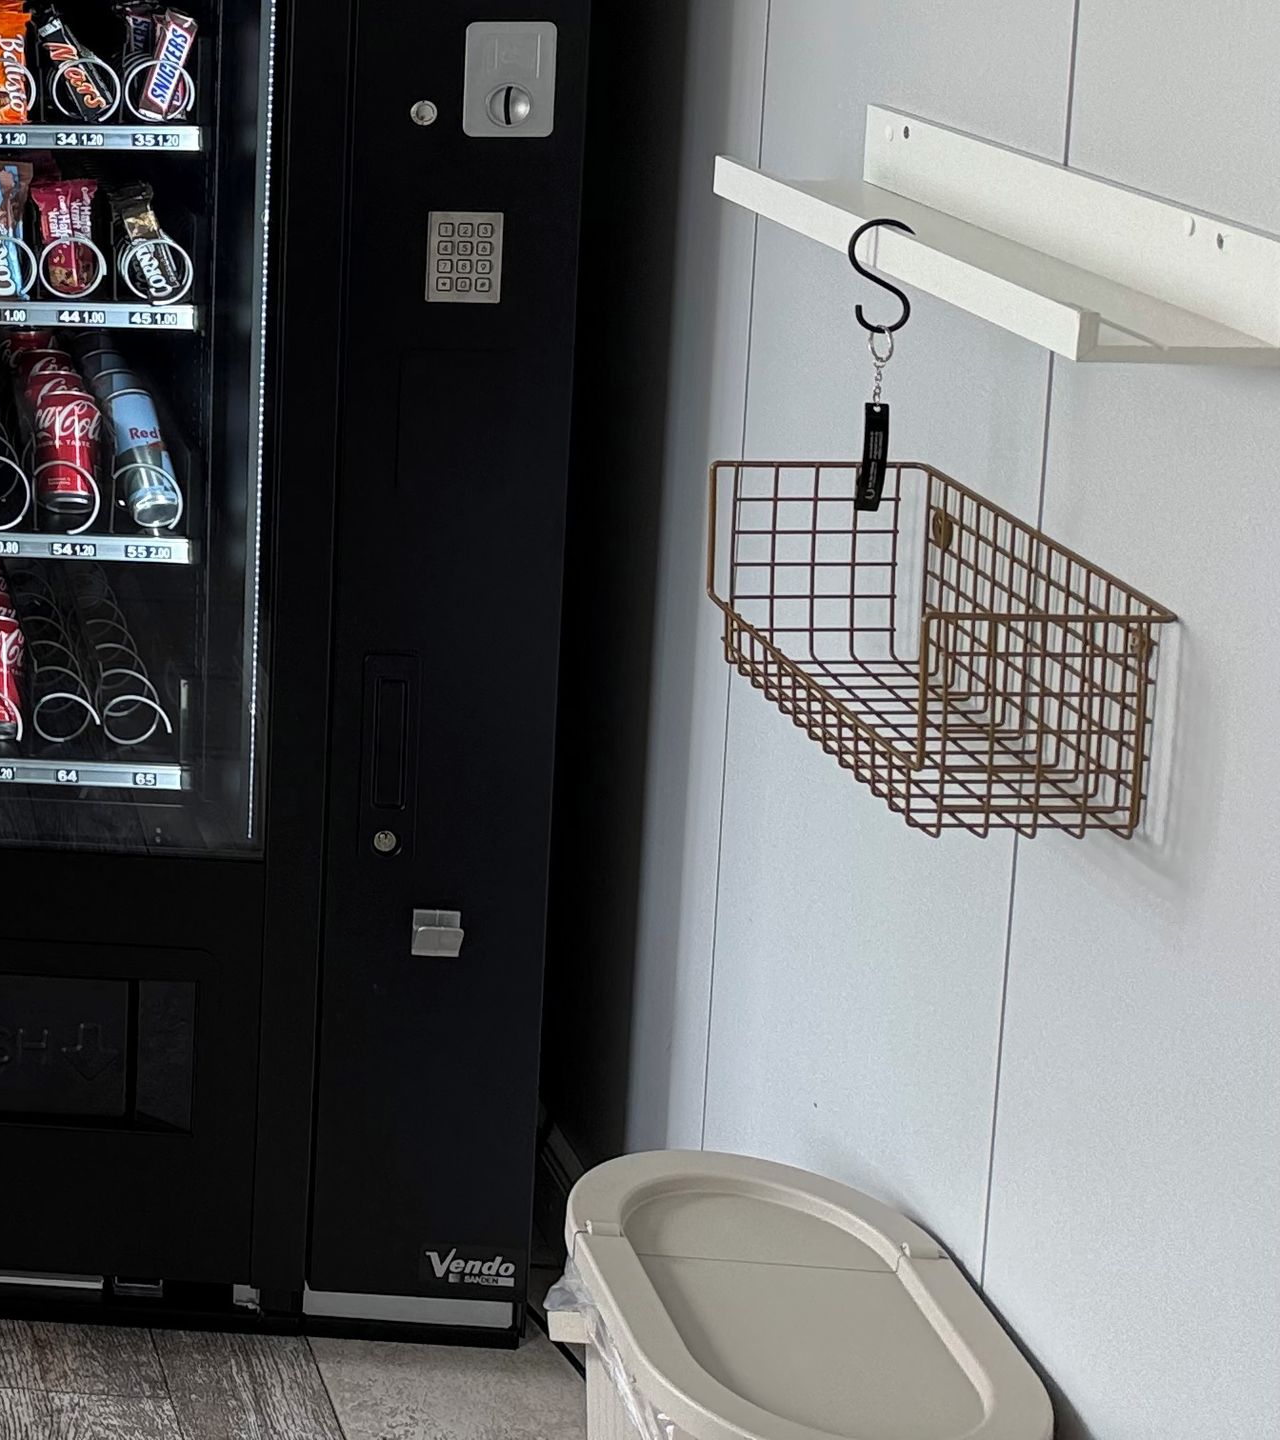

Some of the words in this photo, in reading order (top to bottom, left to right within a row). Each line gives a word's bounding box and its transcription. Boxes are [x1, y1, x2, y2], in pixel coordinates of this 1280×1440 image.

[5, 133, 27, 144] 1.20
[57, 134, 78, 145] 34
[81, 134, 103, 145] 1.20
[134, 134, 155, 146] 35
[157, 135, 179, 146] 1.20
[5, 310, 26, 321] 1.00
[60, 311, 81, 322] 44
[83, 312, 105, 323] 1.00
[131, 312, 151, 324] 45
[156, 313, 177, 325] 1.00
[129, 427, 159, 440] Red
[52, 544, 73, 555] 54
[75, 544, 95, 556] 1.20
[128, 546, 147, 557] 55
[150, 547, 171, 558] 2.00
[58, 771, 77, 781] 64
[136, 774, 155, 784] 65
[425, 1248, 515, 1278] Vendo
